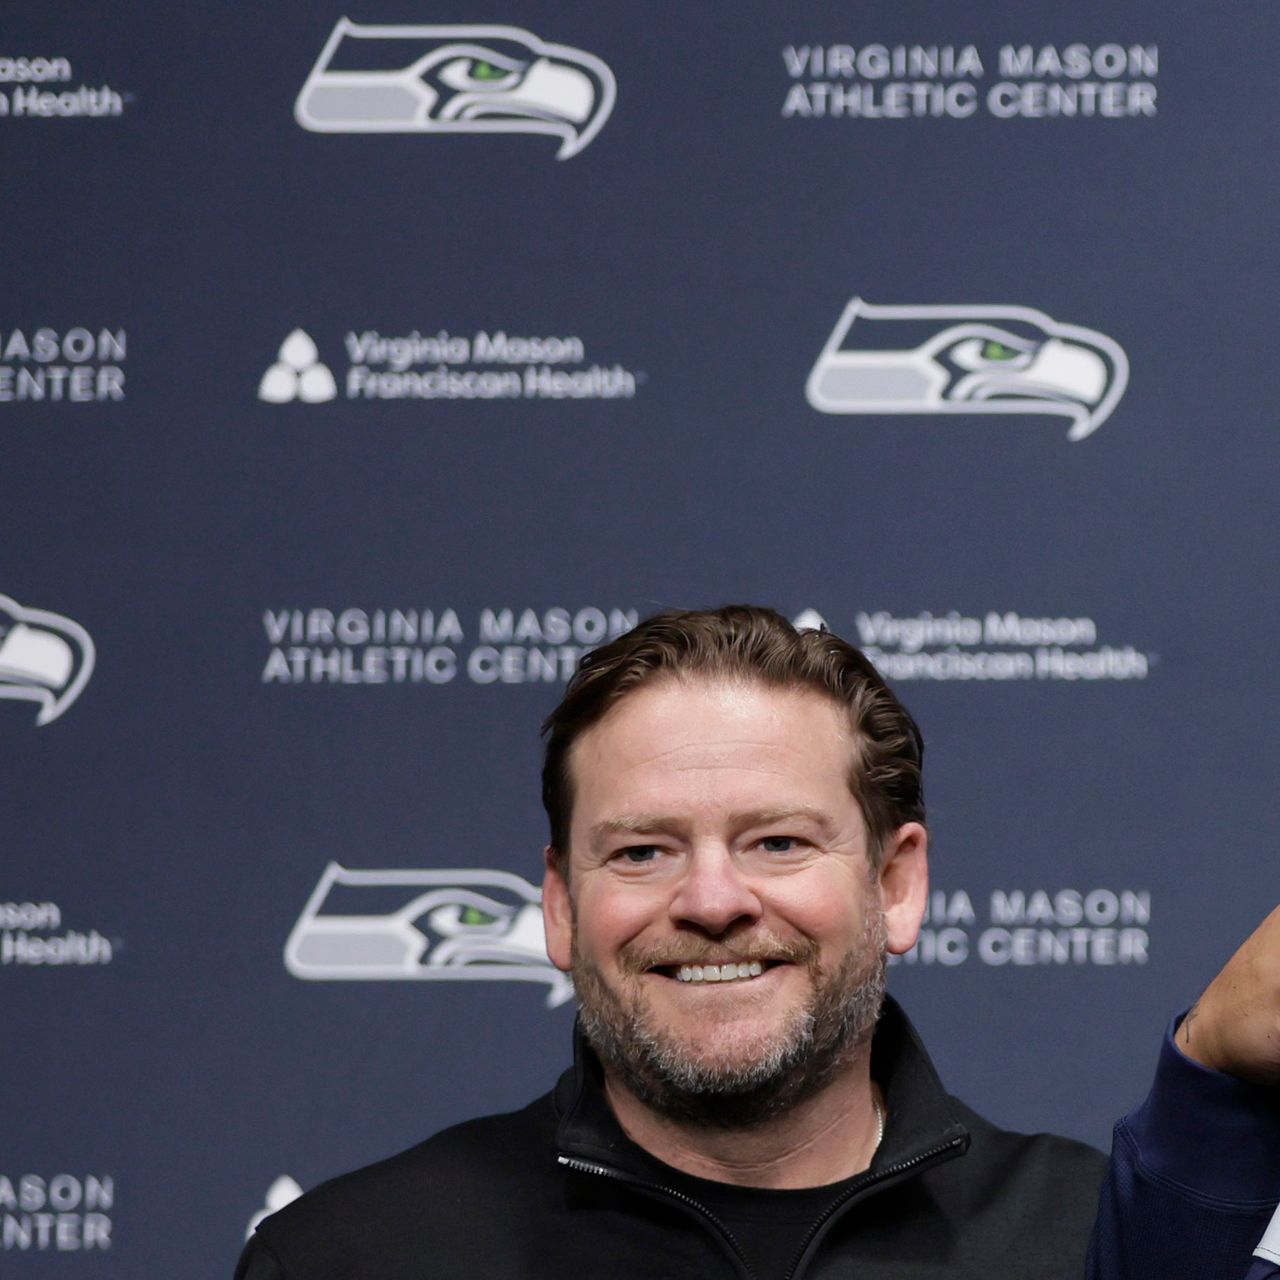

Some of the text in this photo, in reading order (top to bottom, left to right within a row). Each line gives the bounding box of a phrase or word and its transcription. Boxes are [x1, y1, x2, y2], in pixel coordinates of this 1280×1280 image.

[783, 43, 1159, 79] VIRGINIA MASON
[13, 85, 123, 117] Health
[783, 82, 1158, 118] ATHLETIC CENTER
[3, 328, 127, 363] ASON
[344, 330, 585, 372] Virginia Mason
[346, 364, 636, 399] Franciscan Health
[264, 607, 464, 645] VIRGINIA
[855, 611, 1097, 654] Virginia Mason
[263, 646, 588, 684] ATHLETIC CENT
[1034, 645, 1149, 681] Health
[990, 889, 1151, 926] MASON
[1, 930, 112, 965] Health
[978, 926, 1151, 966] CENTER
